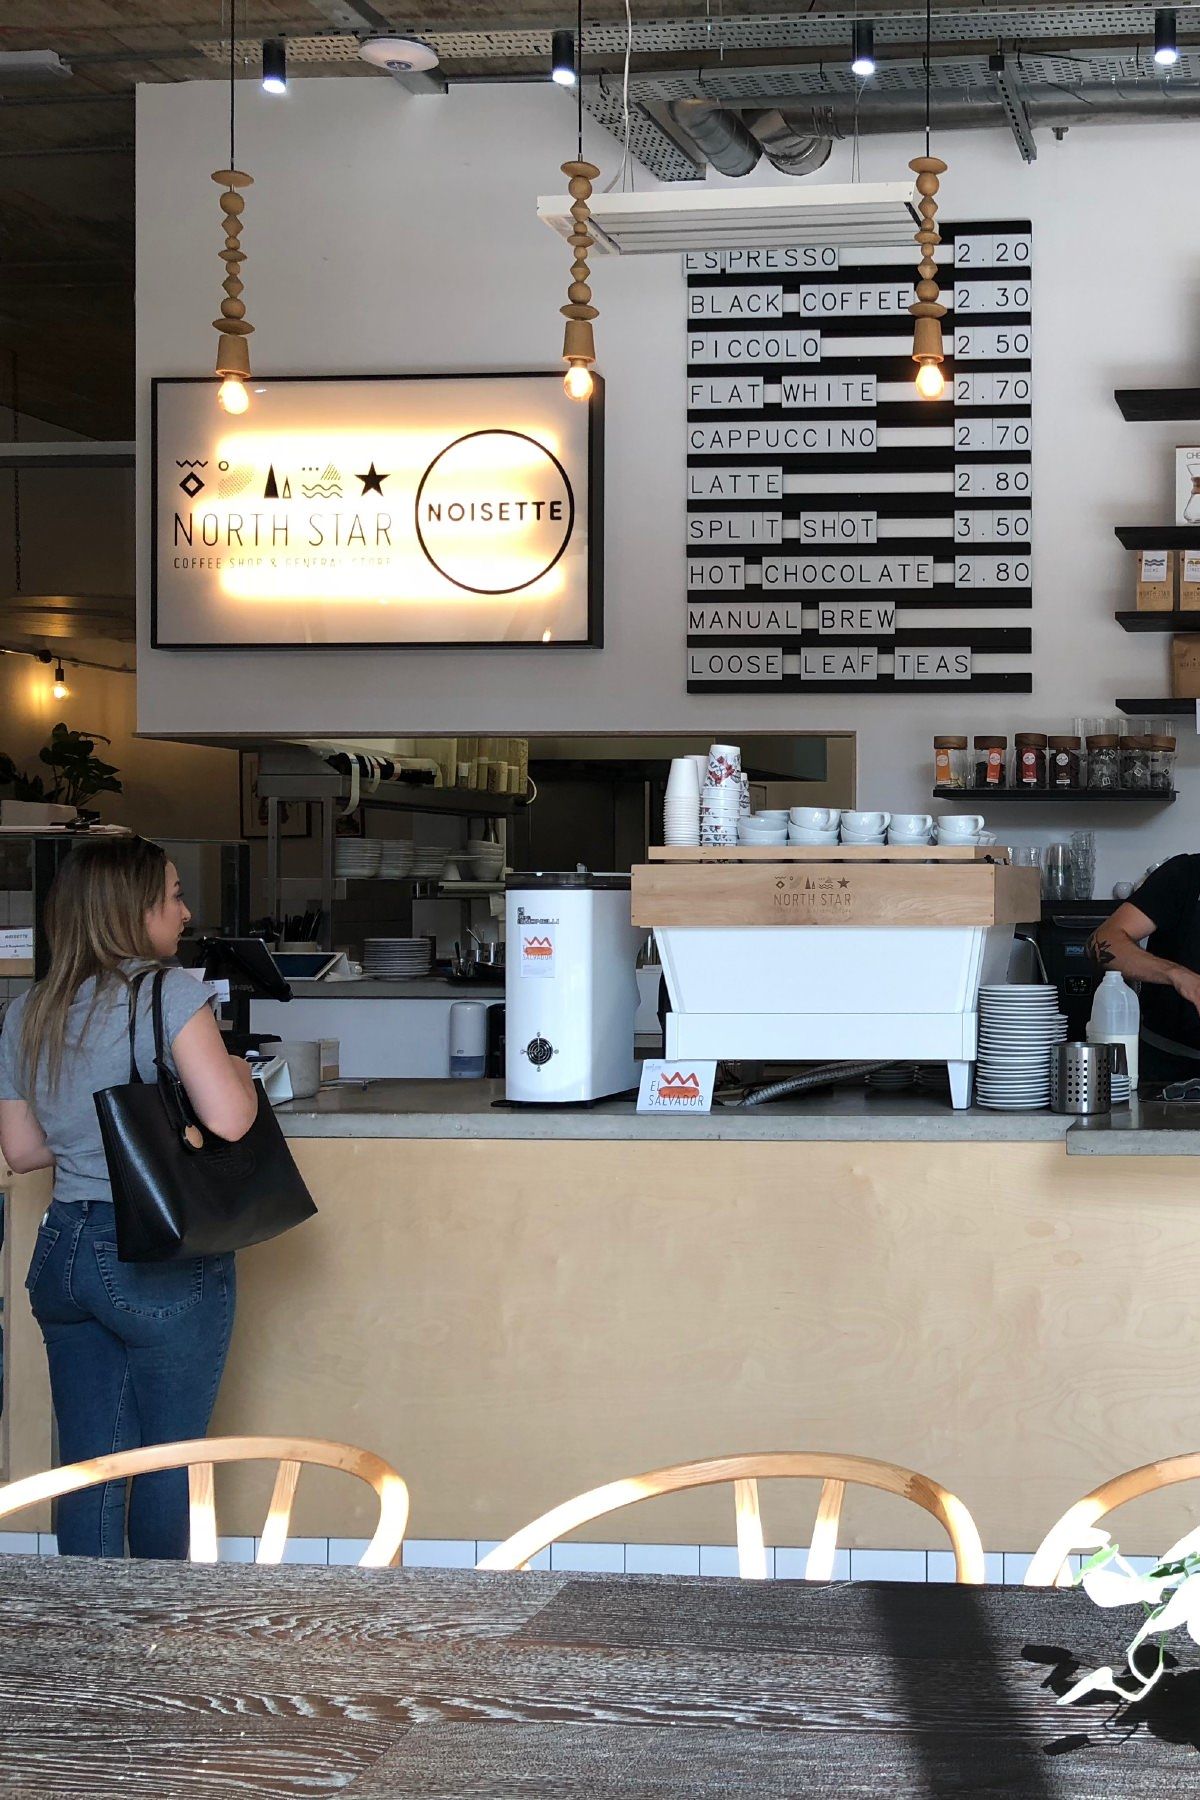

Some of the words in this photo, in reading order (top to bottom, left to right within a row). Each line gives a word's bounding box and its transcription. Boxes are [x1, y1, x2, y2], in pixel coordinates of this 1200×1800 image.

[685, 247, 836, 269] ESPRESSO
[957, 242, 1030, 263] 2.20
[691, 293, 780, 314] BLACK
[802, 290, 910, 311] COFFEE
[957, 288, 1030, 308] 2.30
[691, 338, 819, 359] PICCOLO
[957, 334, 1030, 354] 2.50
[691, 384, 760, 404] FLAT
[783, 381, 874, 402] WHITE
[957, 380, 1030, 401] 2.70
[690, 427, 875, 449] CAPPUCCINO
[957, 425, 1030, 446] 2.70
[691, 474, 779, 494] LATTE
[957, 472, 1030, 492] 2.80
[428, 500, 562, 521] NOISETTE
[174, 512, 288, 547] NORTH
[308, 512, 392, 547] STAR
[690, 519, 779, 539] SPLIT
[803, 518, 874, 538] SHOT
[957, 517, 1030, 537] 3.50
[174, 557, 222, 570] COFFEE
[285, 557, 343, 569] GENERA
[690, 564, 743, 585] HOT
[764, 563, 931, 584] CHOCOLATE
[957, 562, 1031, 583] 2.80
[689, 609, 798, 629] MANUAL
[820, 608, 895, 628] BREW
[691, 655, 779, 674] LOOSE
[804, 655, 874, 674] LEAF
[898, 655, 969, 674] TEAS
[774, 893, 815, 907] NORTH
[820, 893, 851, 907] STAR
[651, 1080, 662, 1092] EL
[648, 1094, 704, 1106] SALVADOR
